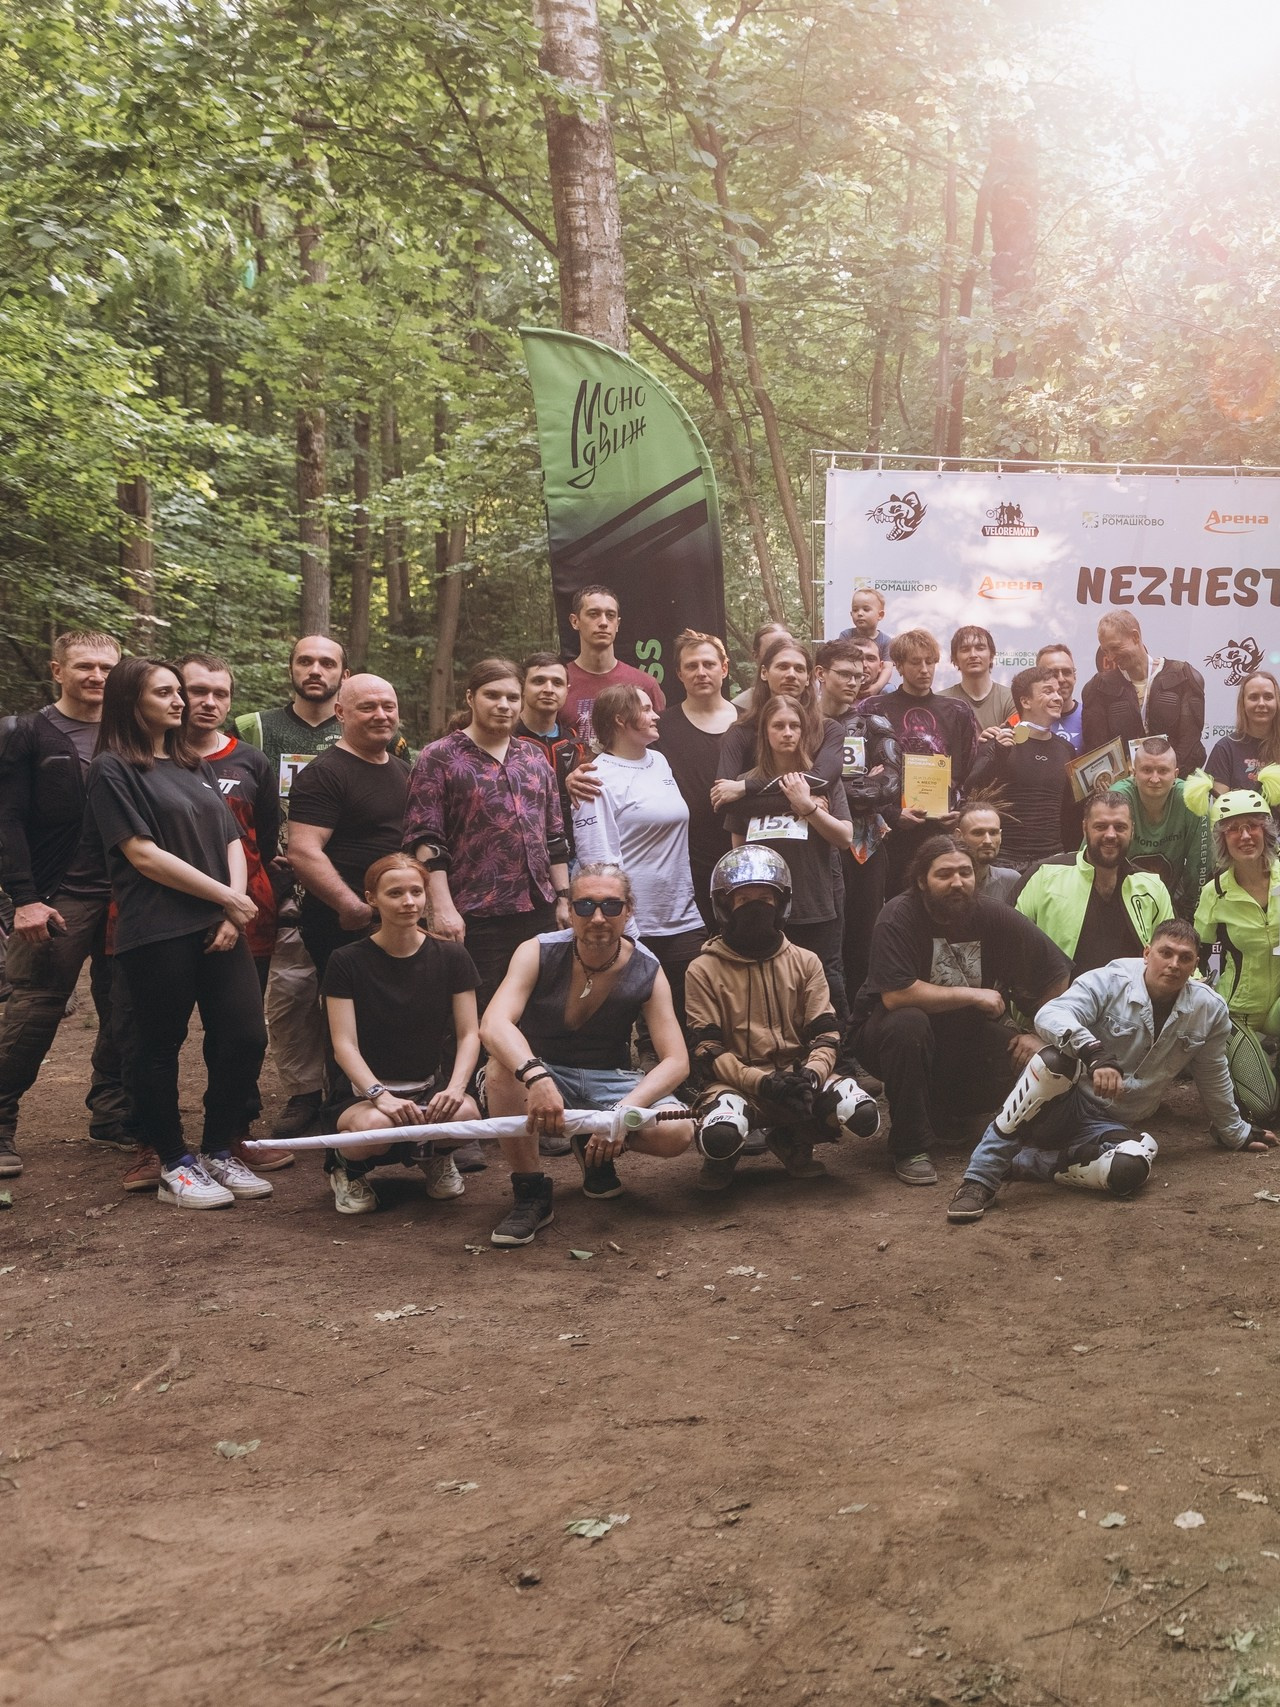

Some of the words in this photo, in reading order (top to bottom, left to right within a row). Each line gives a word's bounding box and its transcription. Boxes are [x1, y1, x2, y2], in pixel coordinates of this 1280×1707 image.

[1102, 518, 1165, 527] РОМАШКОВО
[1206, 510, 1269, 525] Арена
[985, 526, 1036, 536] VELOREMONT
[874, 584, 938, 592] РОМАШКОВО
[979, 576, 1043, 591] Арена
[996, 657, 1036, 667] ЧЕЛОВ
[707, 1114, 734, 1126] LEATT
